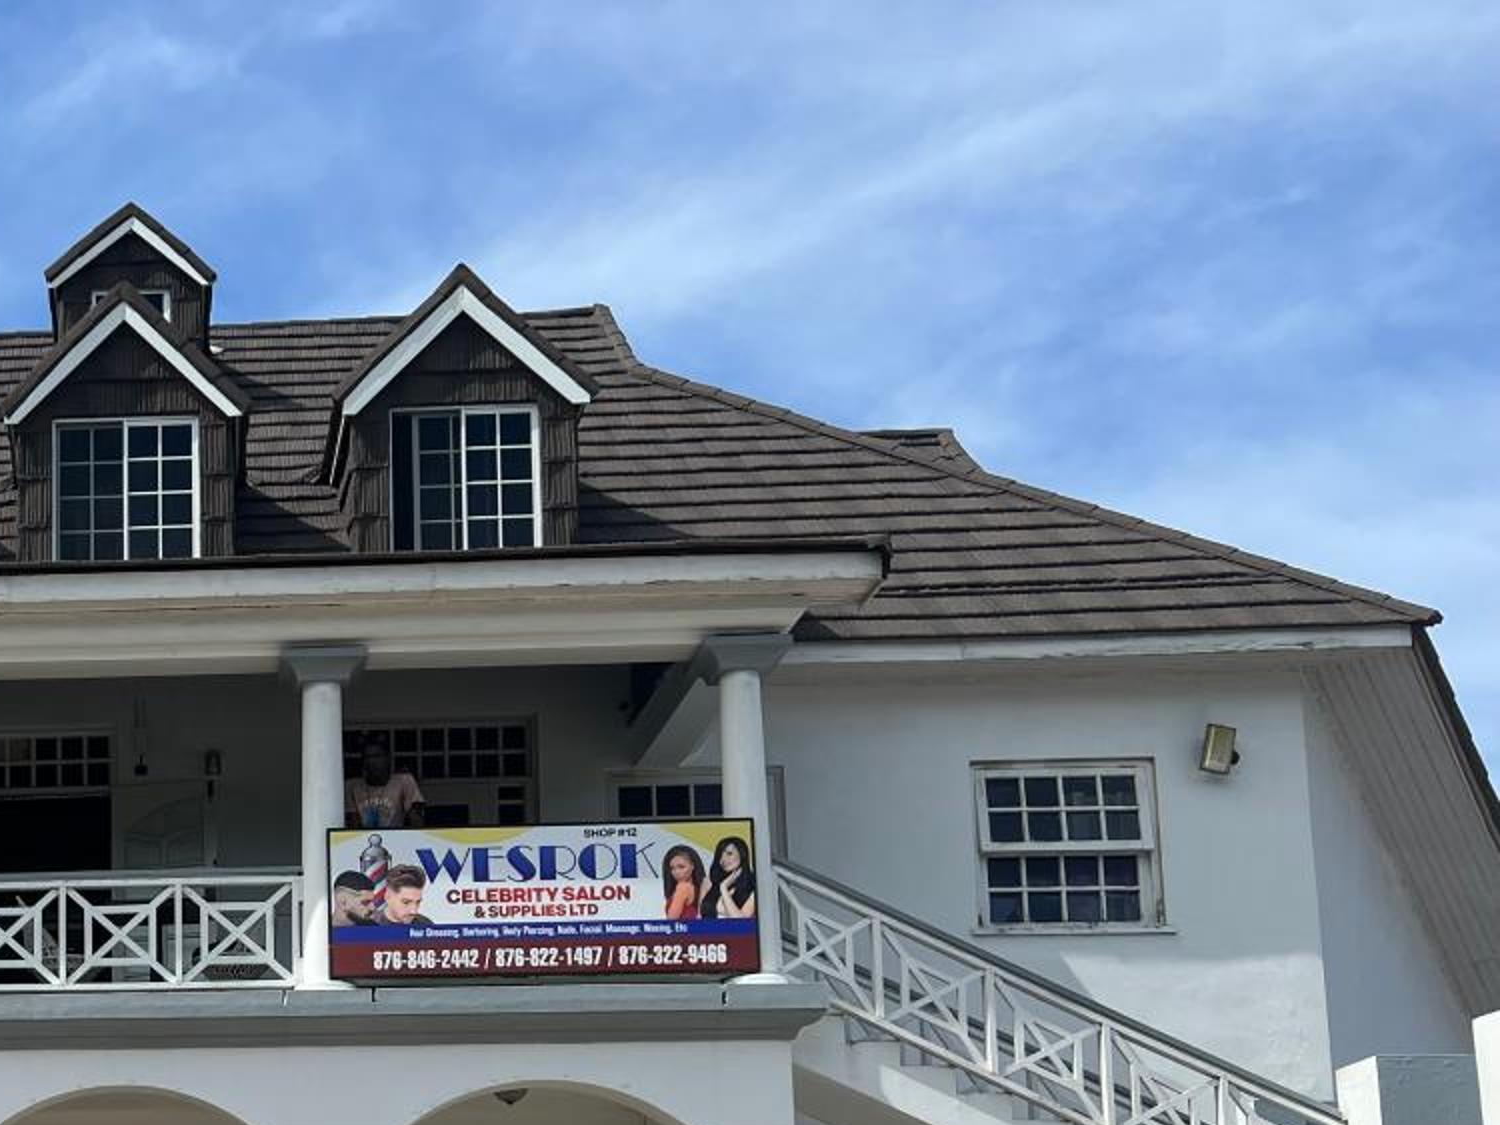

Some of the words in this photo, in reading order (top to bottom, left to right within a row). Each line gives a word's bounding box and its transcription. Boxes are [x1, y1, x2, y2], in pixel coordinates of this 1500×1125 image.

[583, 828, 615, 838] SHOP
[617, 827, 637, 837] #12
[416, 842, 659, 885] WESROK
[446, 887, 559, 905] CELEBRITY
[563, 885, 631, 901] SALON
[474, 906, 485, 919] &
[488, 903, 566, 918] SUPPLIES
[570, 903, 599, 916] LTD
[373, 950, 480, 969] 876-846-2442
[495, 947, 603, 967] 876-822-1497
[619, 944, 728, 965] 876-322-9466
